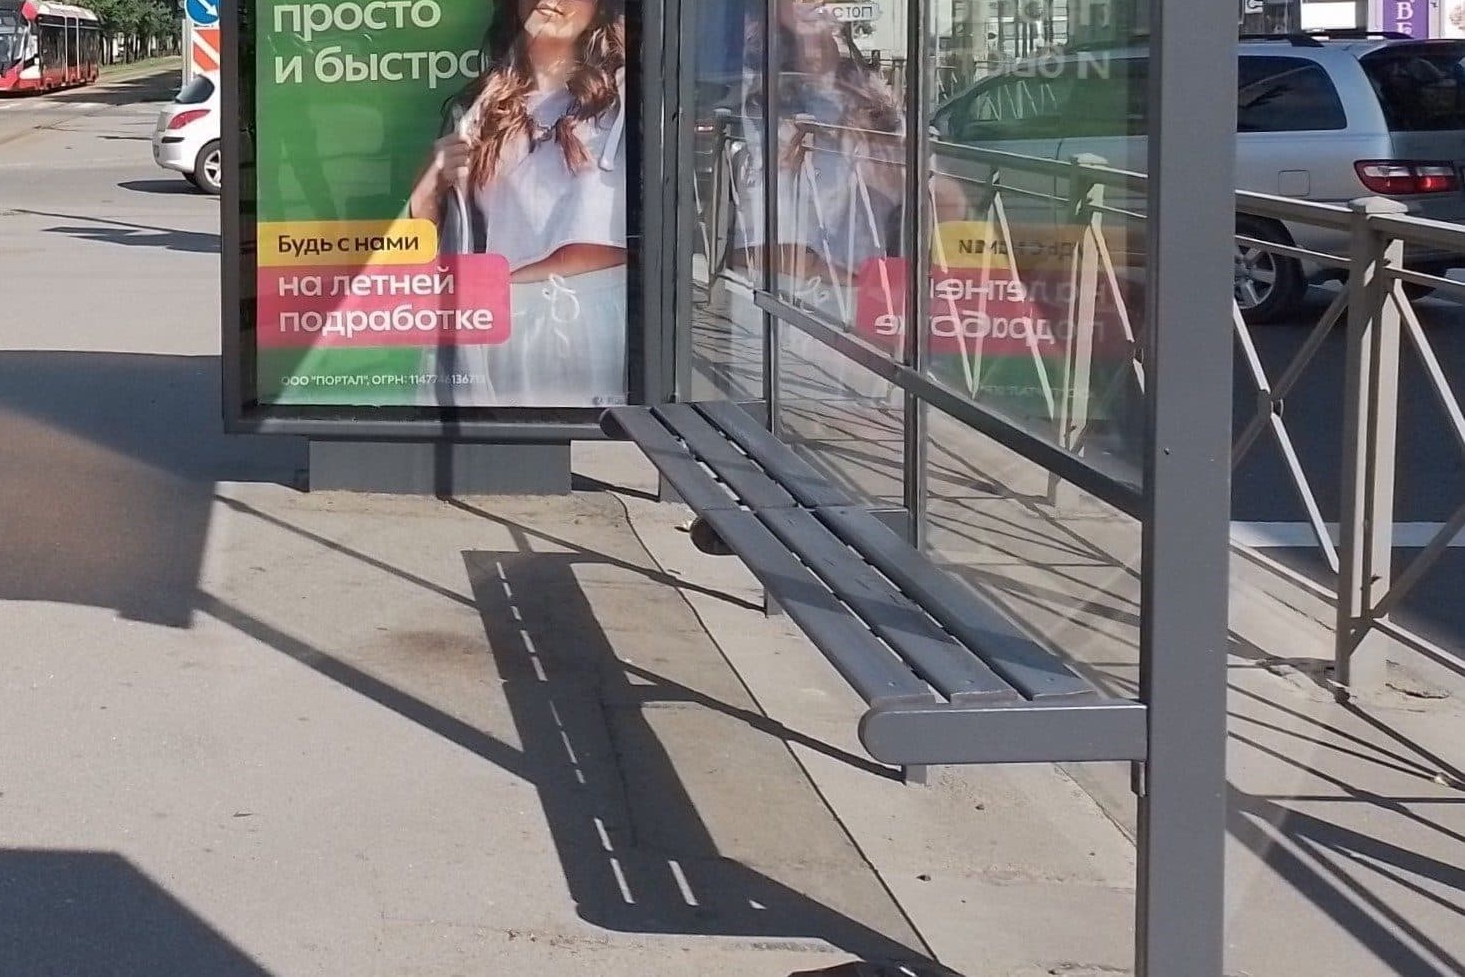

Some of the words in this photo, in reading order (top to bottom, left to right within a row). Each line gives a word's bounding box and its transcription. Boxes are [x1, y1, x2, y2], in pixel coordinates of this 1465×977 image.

[273, 0, 442, 42] просто
[832, 6, 873, 18] СТОП
[275, 55, 303, 84] и
[278, 235, 333, 257] Будь
[338, 237, 349, 252] с
[355, 236, 419, 252] нами
[279, 274, 322, 297] на
[330, 266, 455, 297] летней
[279, 304, 494, 339] подработке
[281, 375, 310, 386] ООО
[372, 374, 408, 385] ОГРН:
